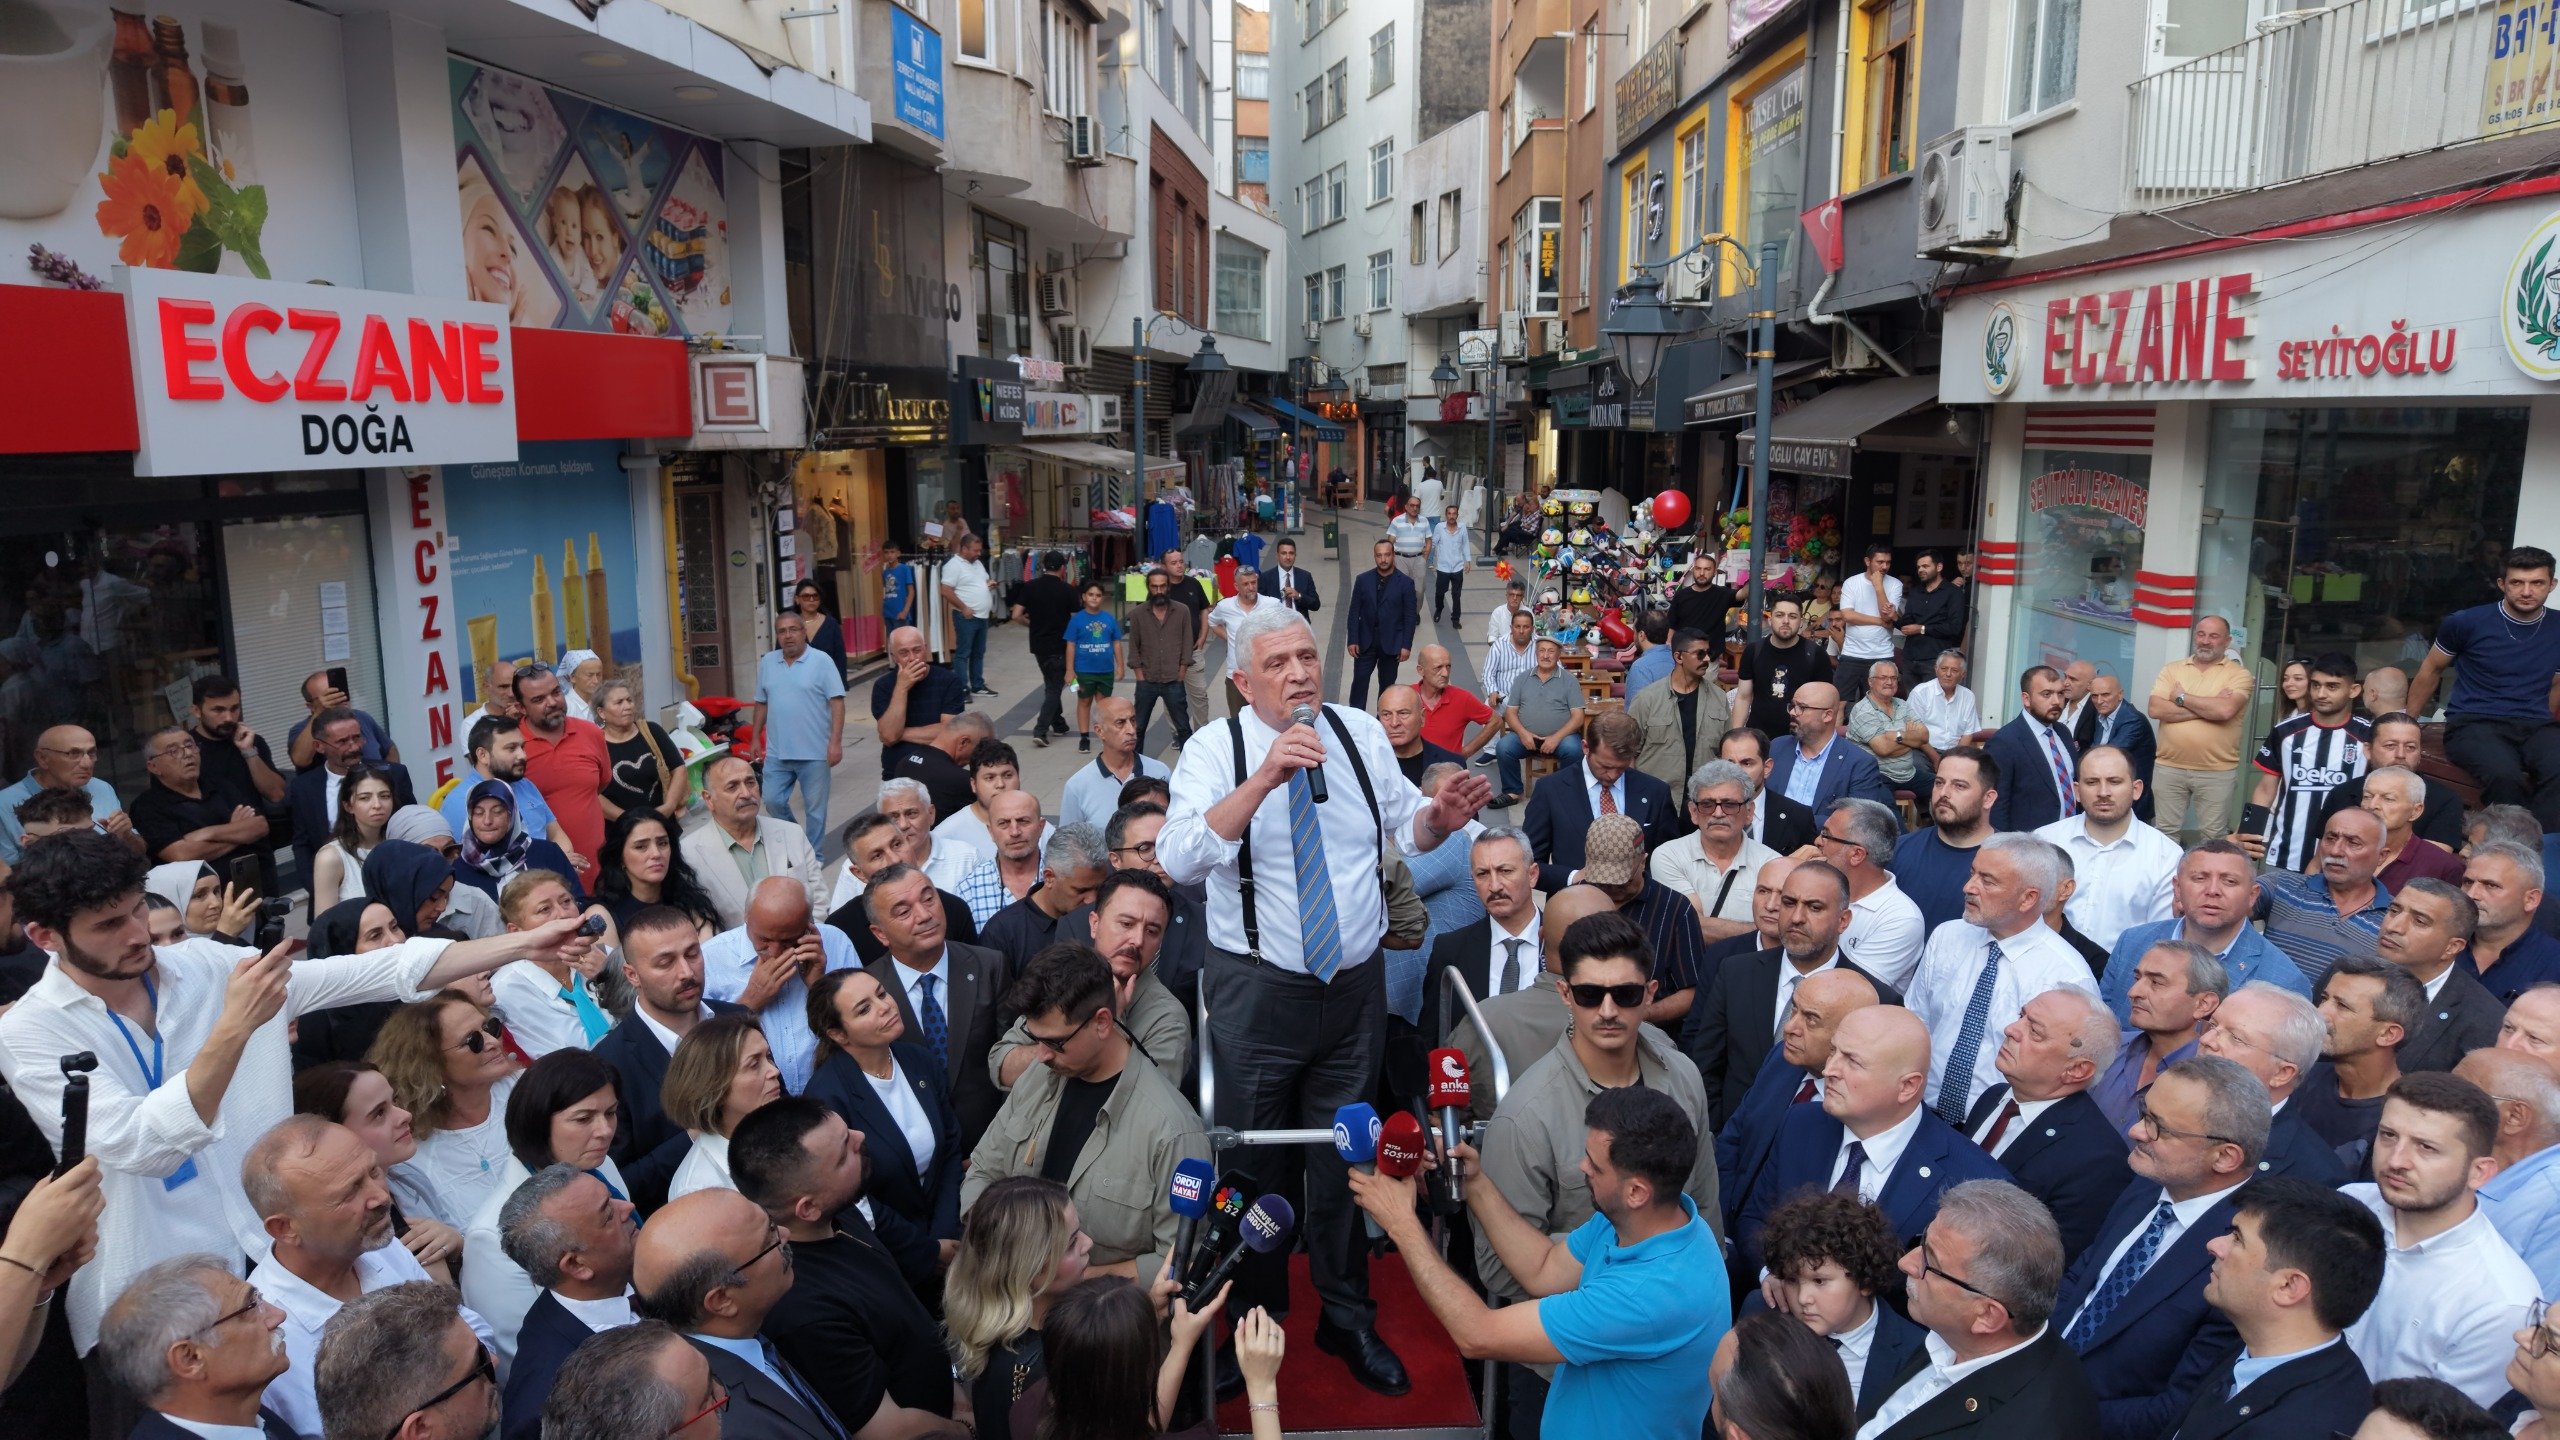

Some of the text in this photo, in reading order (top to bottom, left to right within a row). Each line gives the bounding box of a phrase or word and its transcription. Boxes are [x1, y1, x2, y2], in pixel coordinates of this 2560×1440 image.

[1542, 231, 1555, 277] TERZİ
[2043, 273, 2457, 386] ECZANE SEYİTOĞLU
[157, 297, 505, 404] ECZANE
[713, 372, 750, 417] E
[996, 384, 1022, 400] NEFES
[999, 402, 1021, 420] KİDS
[301, 404, 414, 455] DOĞA
[1794, 446, 1812, 468] ÇAY
[471, 464, 517, 480] Güneşten
[2029, 459, 2091, 513] SEYİTOĞLU
[2293, 763, 2347, 785] beko
[1440, 1078, 1470, 1090] anka
[1383, 1149, 1420, 1160] SOSYAL
[1173, 1184, 1198, 1199] HAYAT
[1175, 1174, 1200, 1189] ORDU
[1224, 1204, 1240, 1217] 52
[1252, 1202, 1281, 1233] KONUŞAN
[1246, 1212, 1275, 1240] ORDU TV
